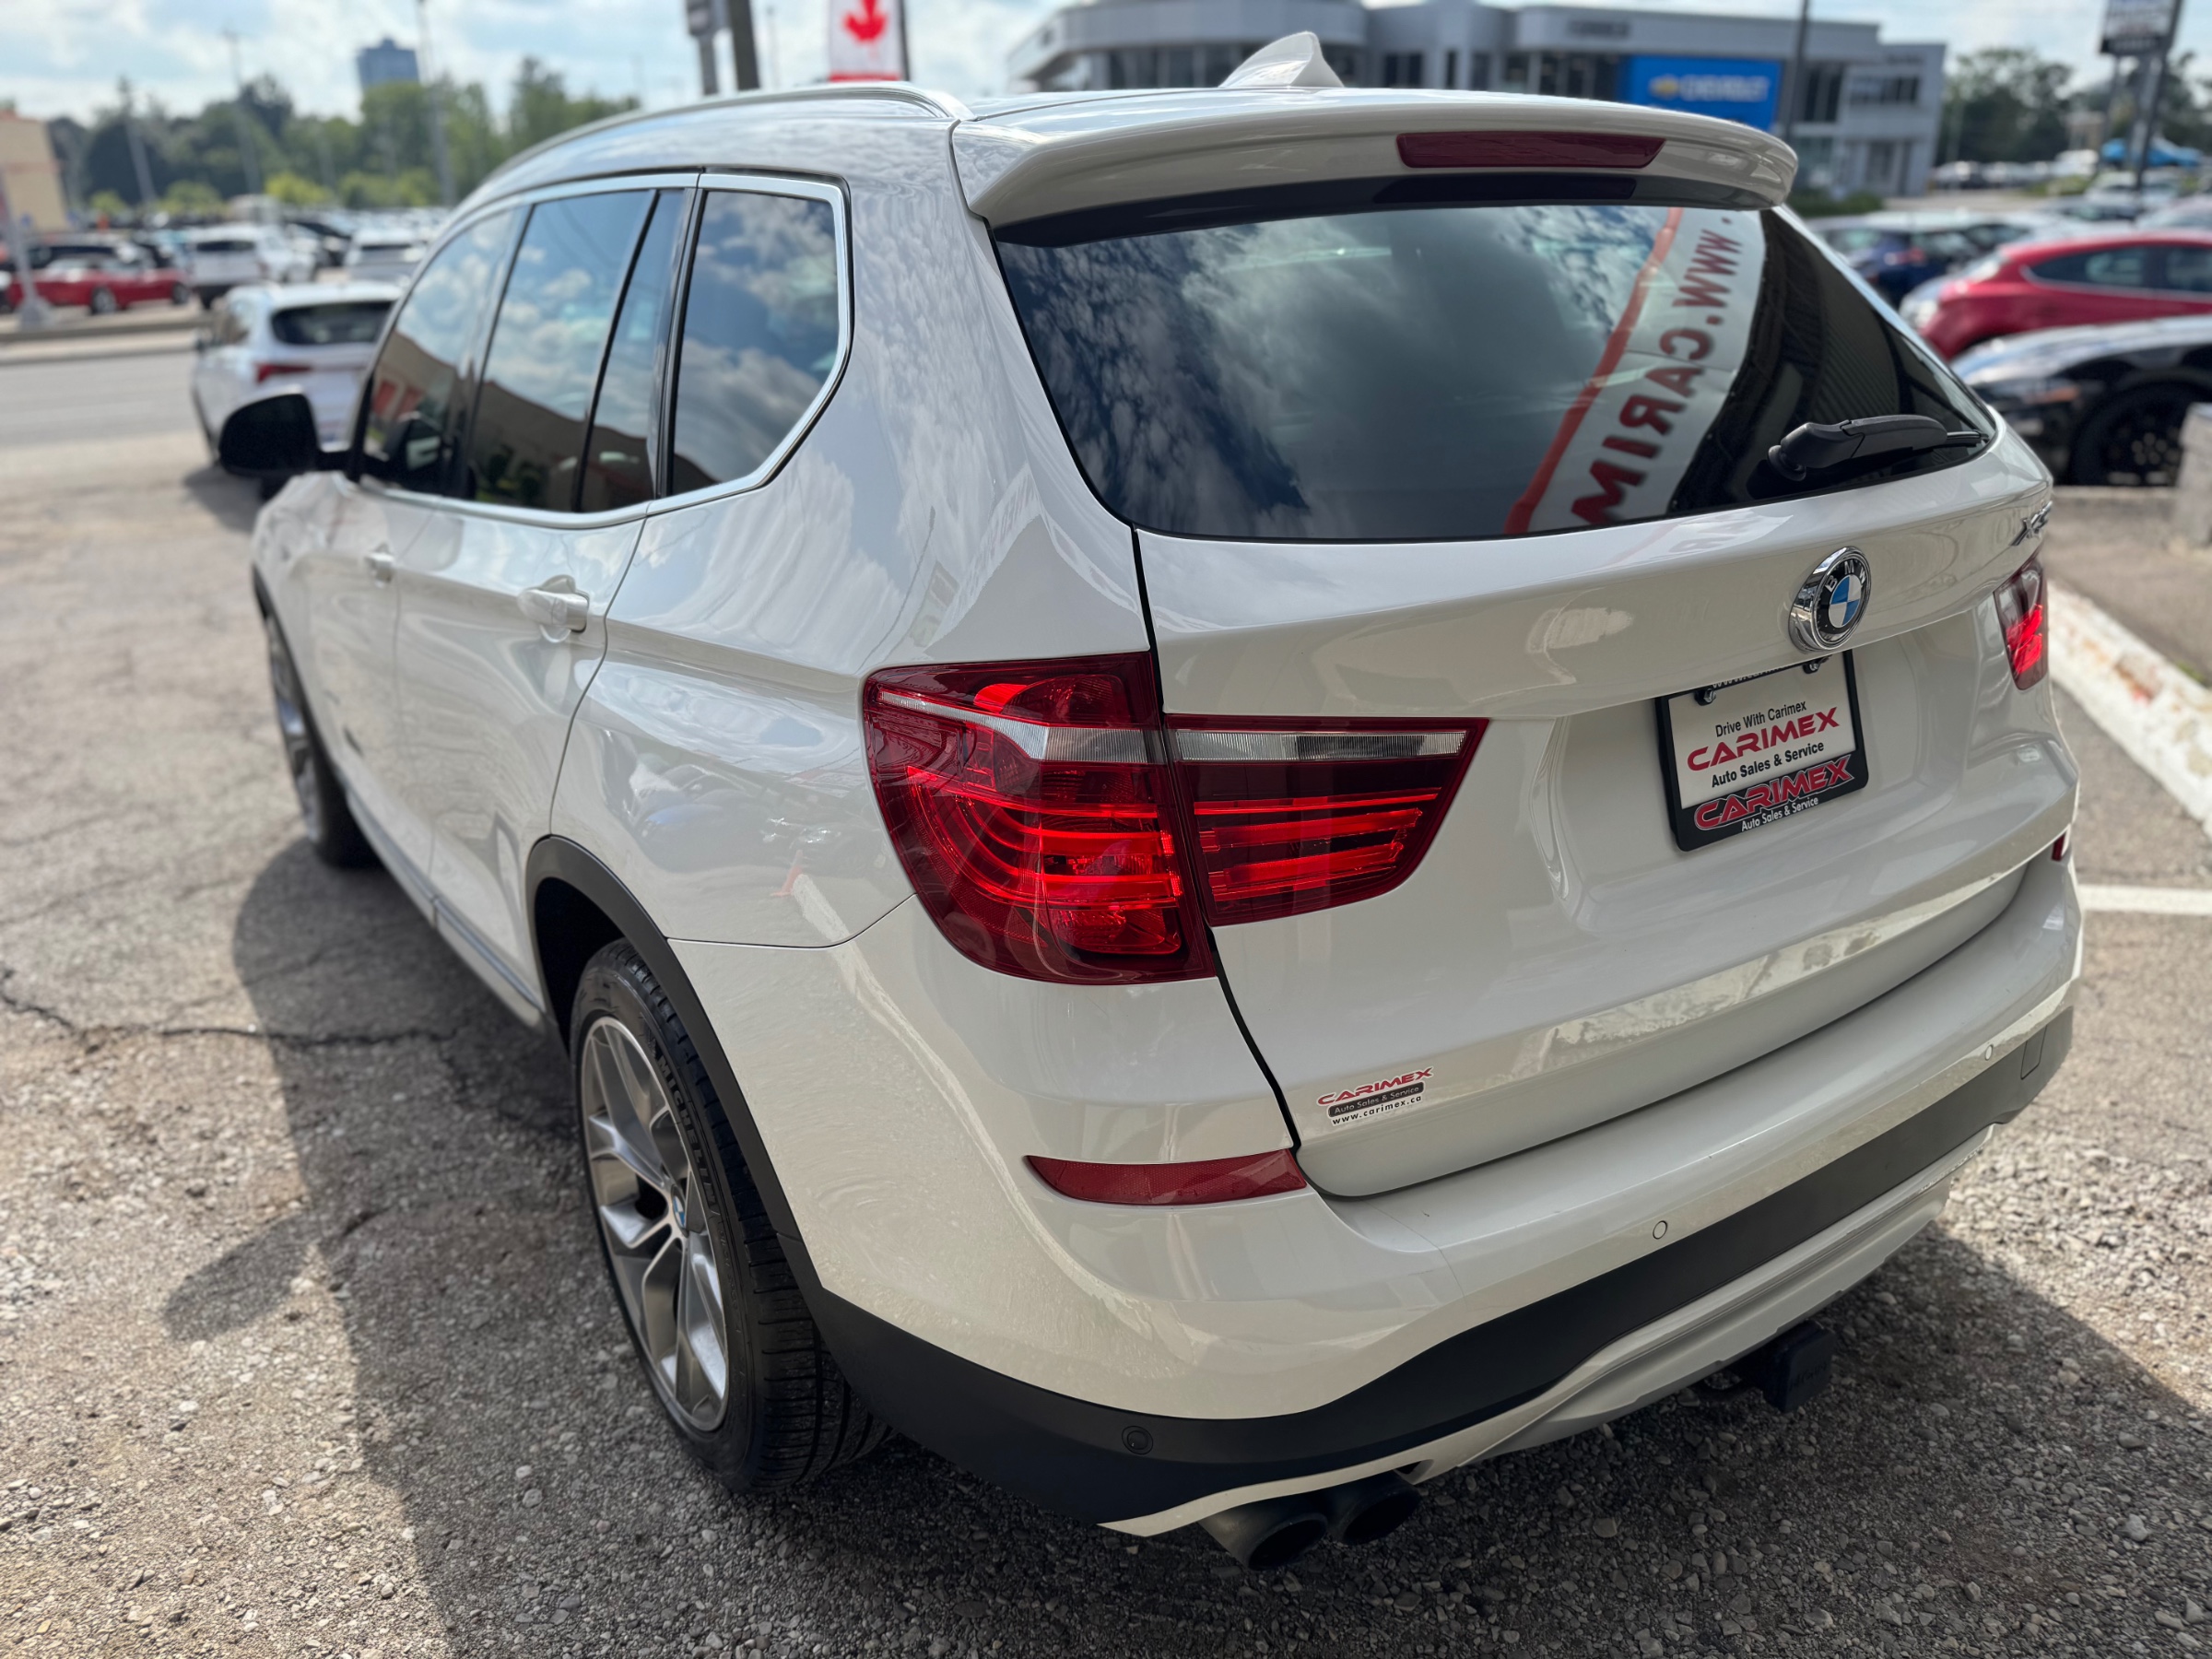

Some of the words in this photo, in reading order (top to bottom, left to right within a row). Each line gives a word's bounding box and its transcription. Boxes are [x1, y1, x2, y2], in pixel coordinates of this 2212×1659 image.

[1825, 559, 1867, 593] BMW
[1714, 721, 1742, 737] Drive
[1743, 712, 1766, 729] With
[1768, 700, 1806, 721] Carimex
[1687, 706, 1840, 771] CARIMEX
[1712, 771, 1737, 788] Auto
[1740, 759, 1771, 778] Sales
[1773, 753, 1783, 767] &
[1784, 742, 1824, 762] Service
[1694, 756, 1853, 830] CARIMEX
[1741, 817, 1760, 832] Auto
[1761, 808, 1783, 825] Sales
[1784, 805, 1791, 816] &
[1792, 795, 1818, 813] Service
[1318, 1067, 1432, 1105] CARIMEX
[1334, 1104, 1355, 1114] Auto
[1357, 1098, 1379, 1109] Sales
[1390, 1087, 1419, 1099] Service
[1332, 1095, 1422, 1124] www.carimex.ca
[656, 1055, 717, 1206] MICHELIN
